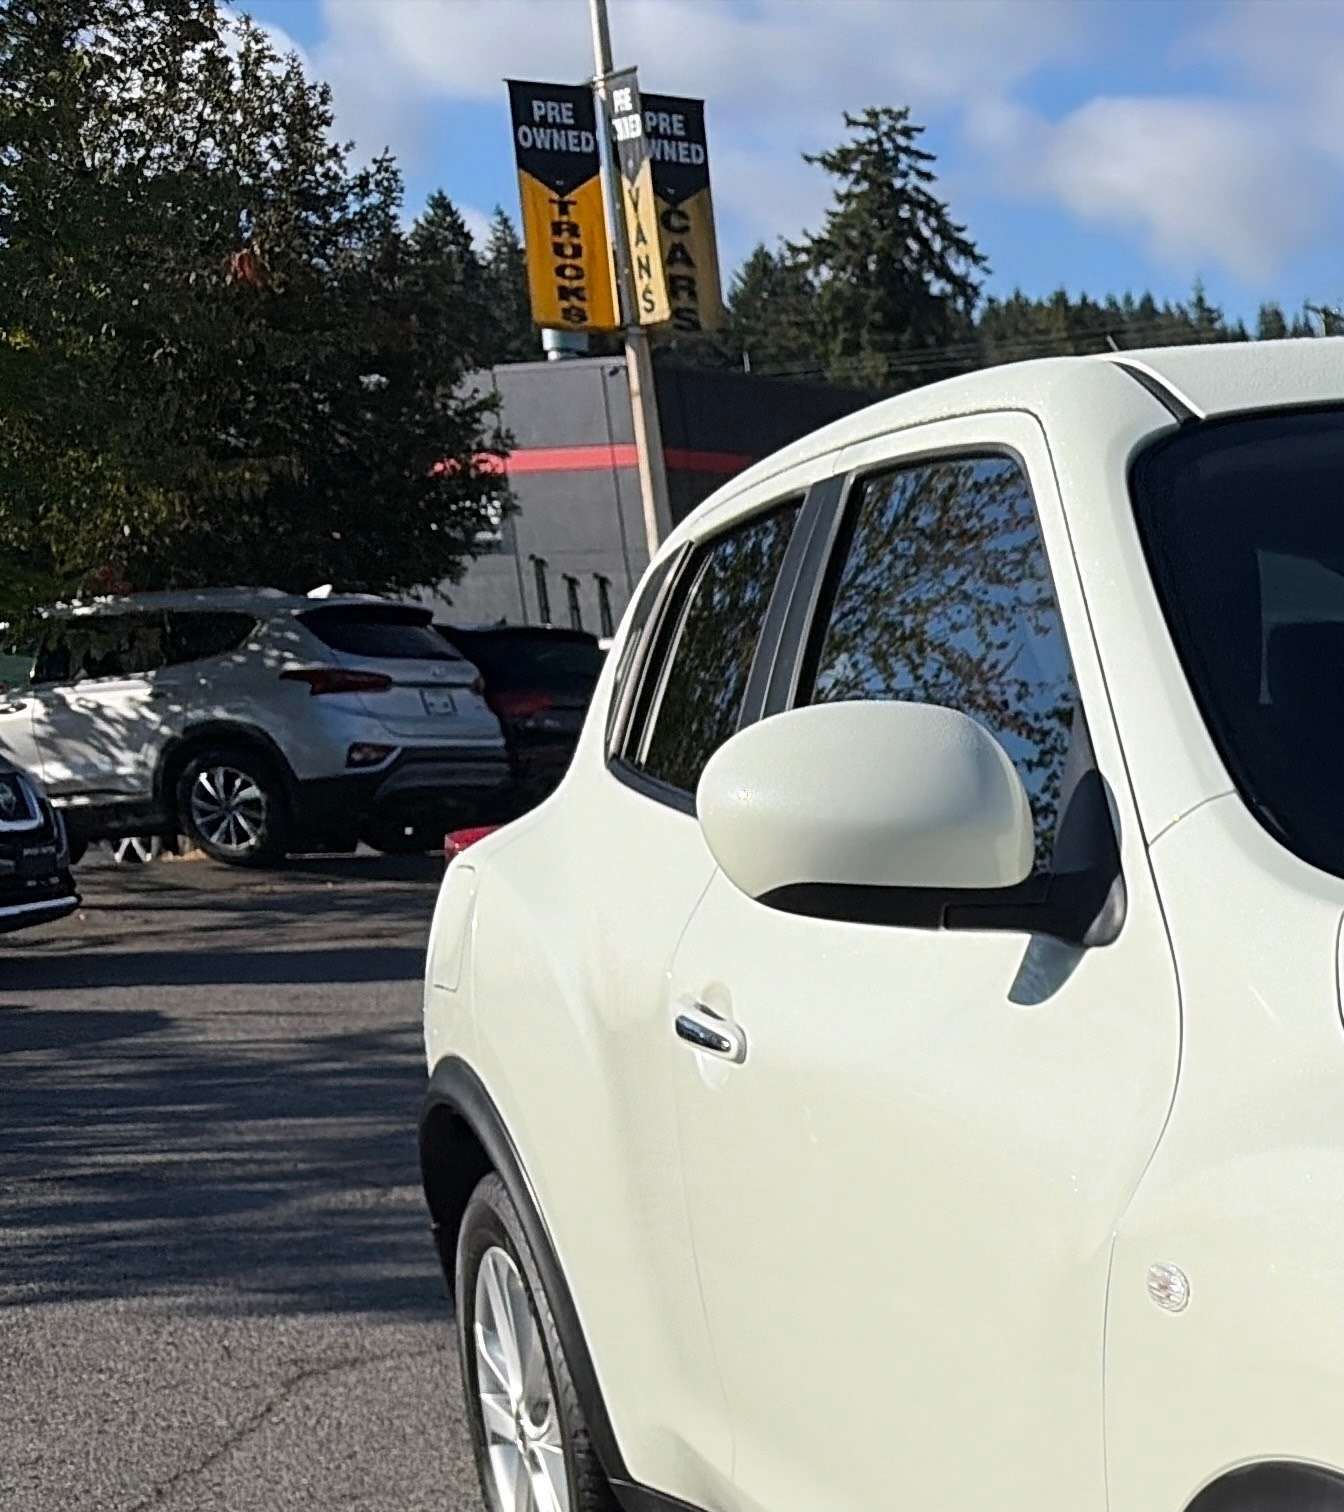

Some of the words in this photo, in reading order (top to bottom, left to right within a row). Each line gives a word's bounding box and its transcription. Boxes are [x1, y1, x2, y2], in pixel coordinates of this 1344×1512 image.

[531, 100, 574, 124] PRE
[645, 110, 685, 136] PRE
[518, 124, 595, 153] OWNED
[645, 138, 705, 165] WNED
[548, 198, 588, 324] TRUCKS
[628, 187, 655, 313] VANS
[660, 208, 702, 331] CARS
